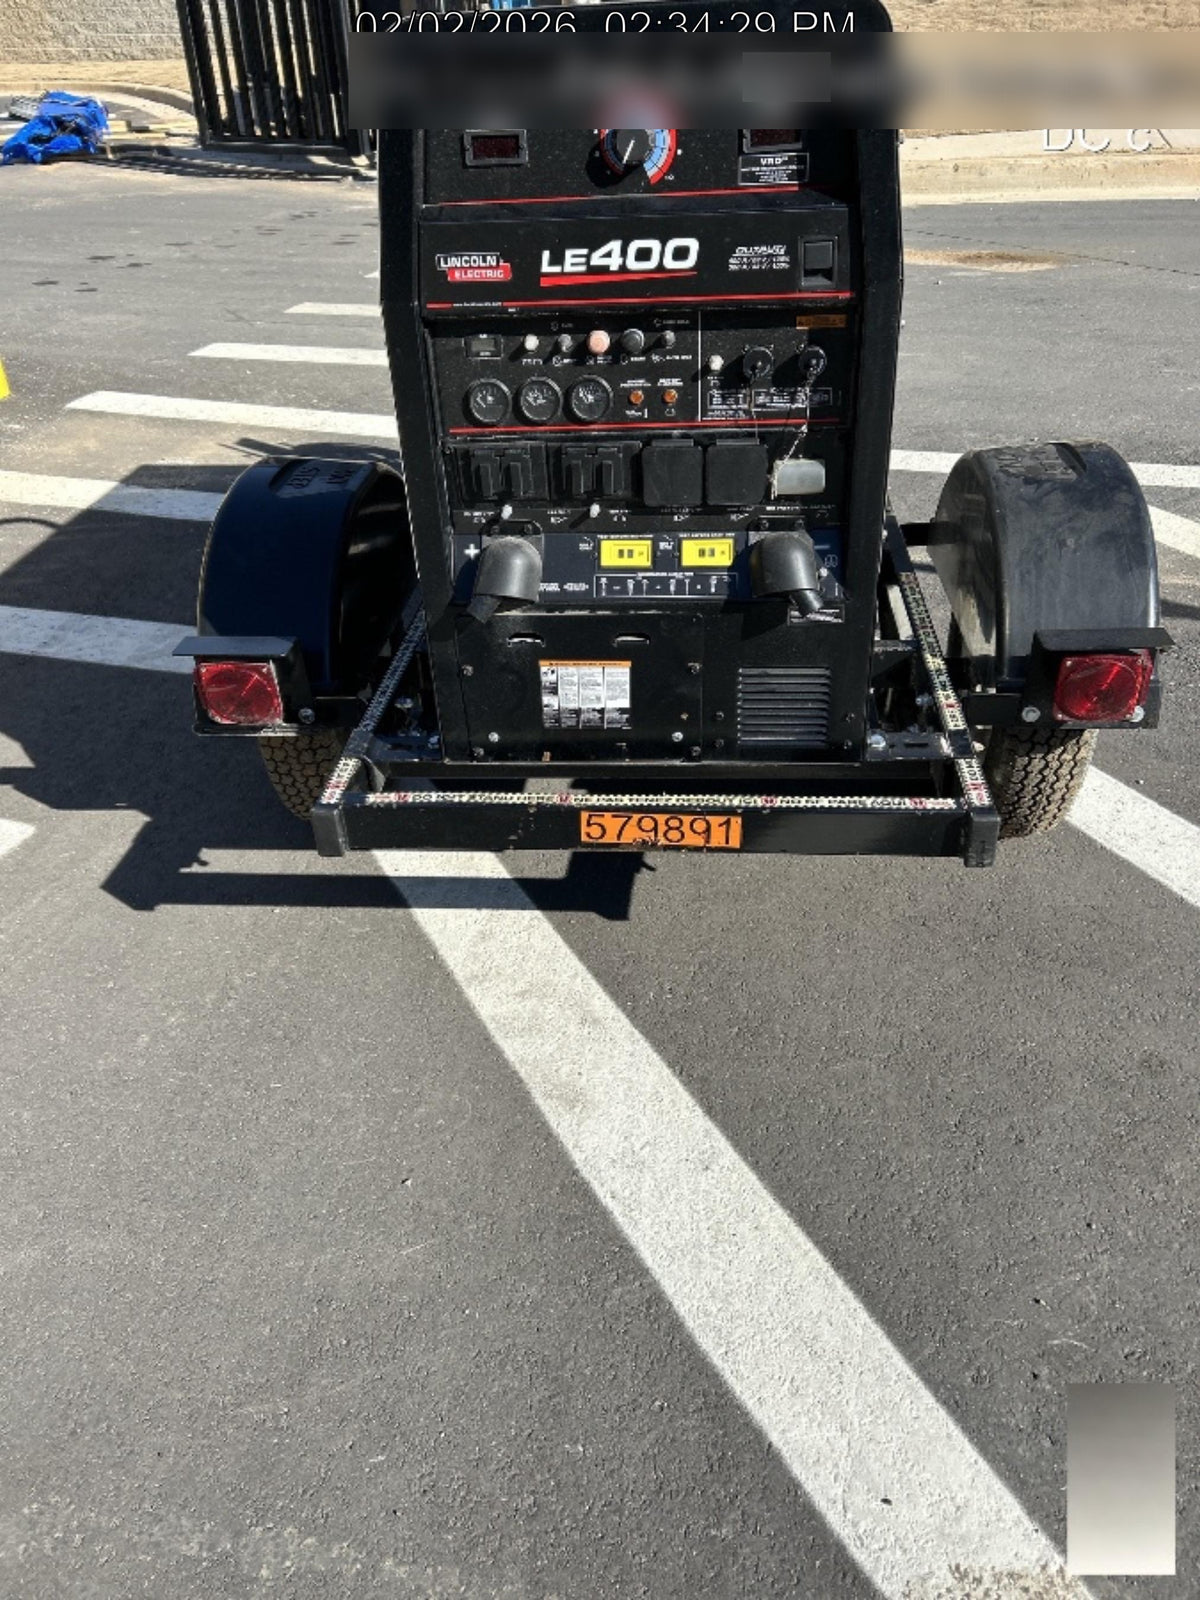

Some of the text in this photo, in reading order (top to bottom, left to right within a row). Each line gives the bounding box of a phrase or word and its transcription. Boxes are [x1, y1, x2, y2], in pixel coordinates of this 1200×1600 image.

[440, 255, 498, 268] LINCOLN
[540, 237, 700, 273] LE400
[454, 269, 504, 279] ELECTRIC
[584, 813, 732, 846] 579891
